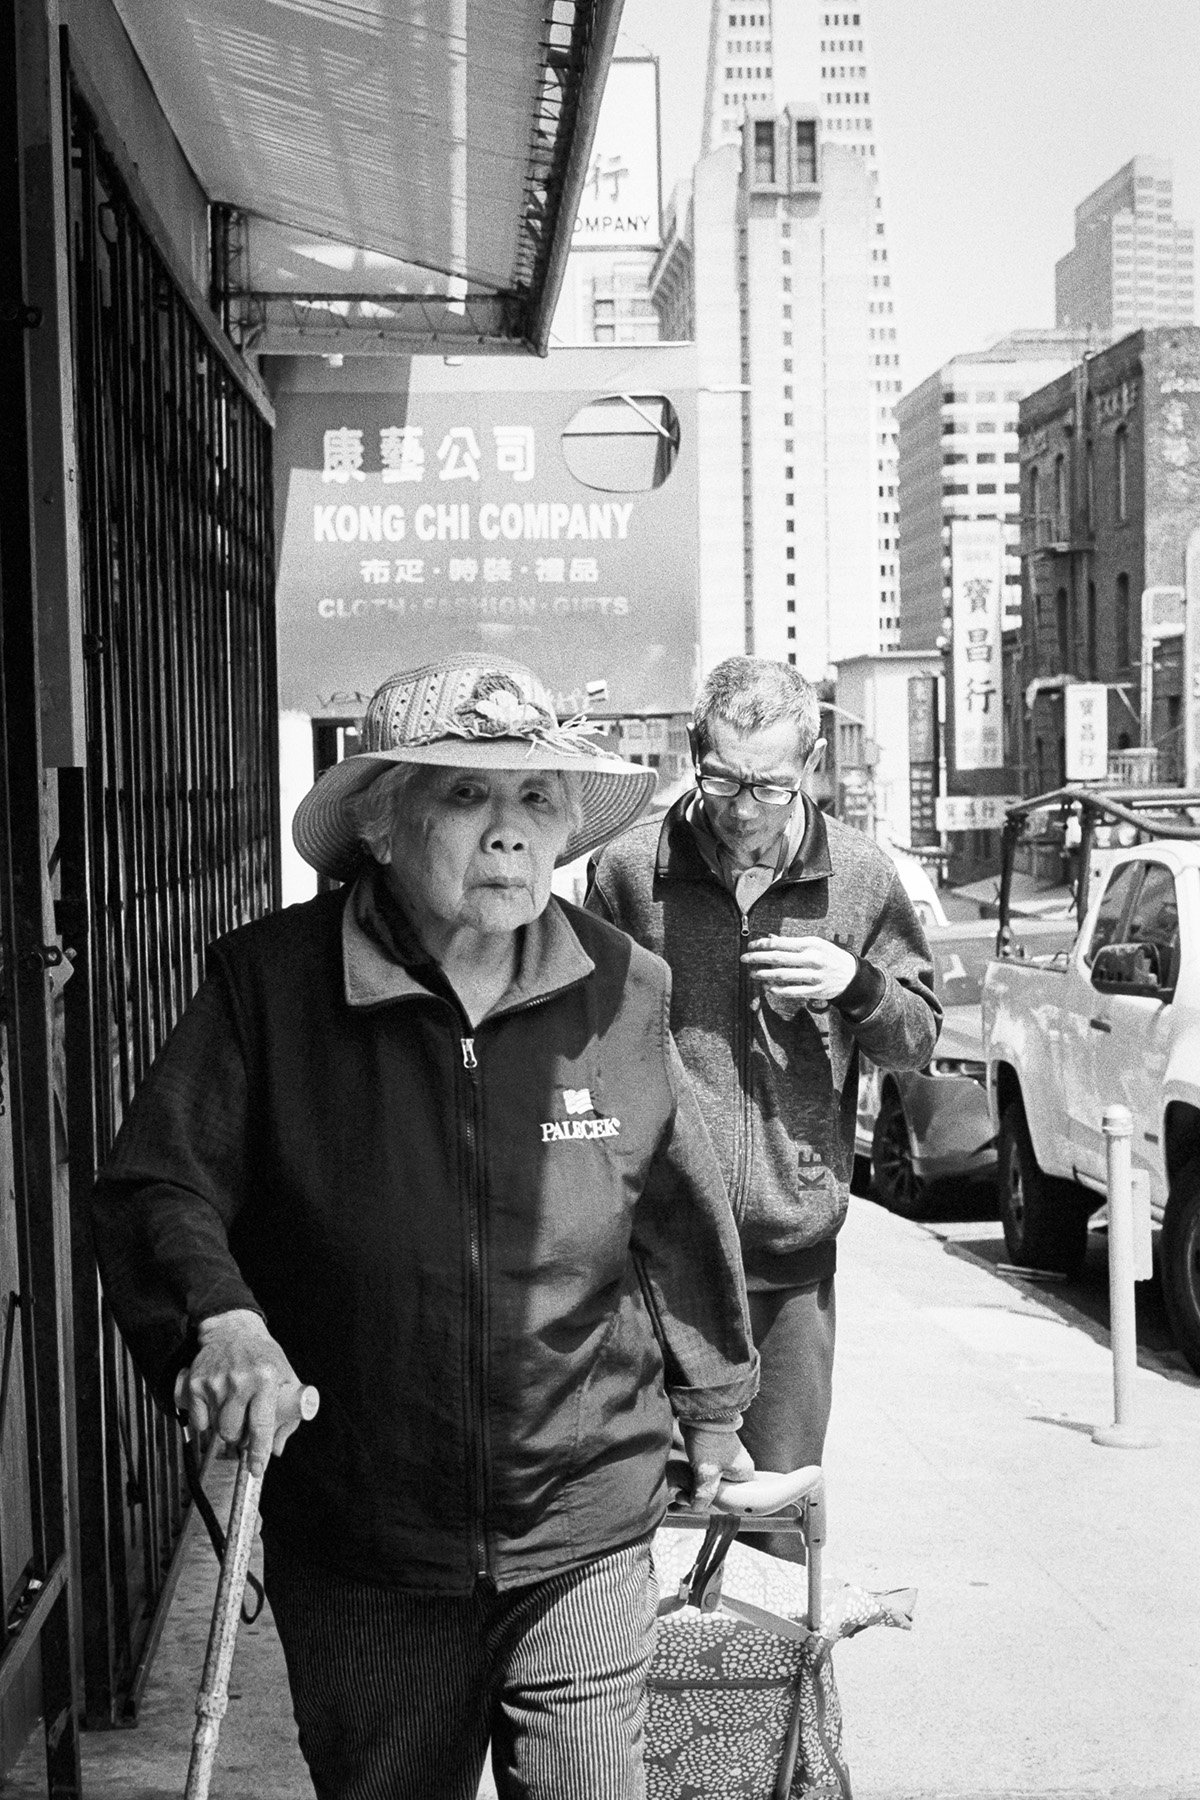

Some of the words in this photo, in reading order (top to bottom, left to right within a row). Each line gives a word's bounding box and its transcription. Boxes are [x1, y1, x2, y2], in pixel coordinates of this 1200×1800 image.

[573, 216, 651, 233] OMPANY
[322, 425, 535, 483] 康藝公司
[313, 503, 405, 542] KONG
[415, 503, 470, 541] CHI
[479, 502, 634, 540] COMPANY
[540, 1117, 621, 1142] PALECEK
